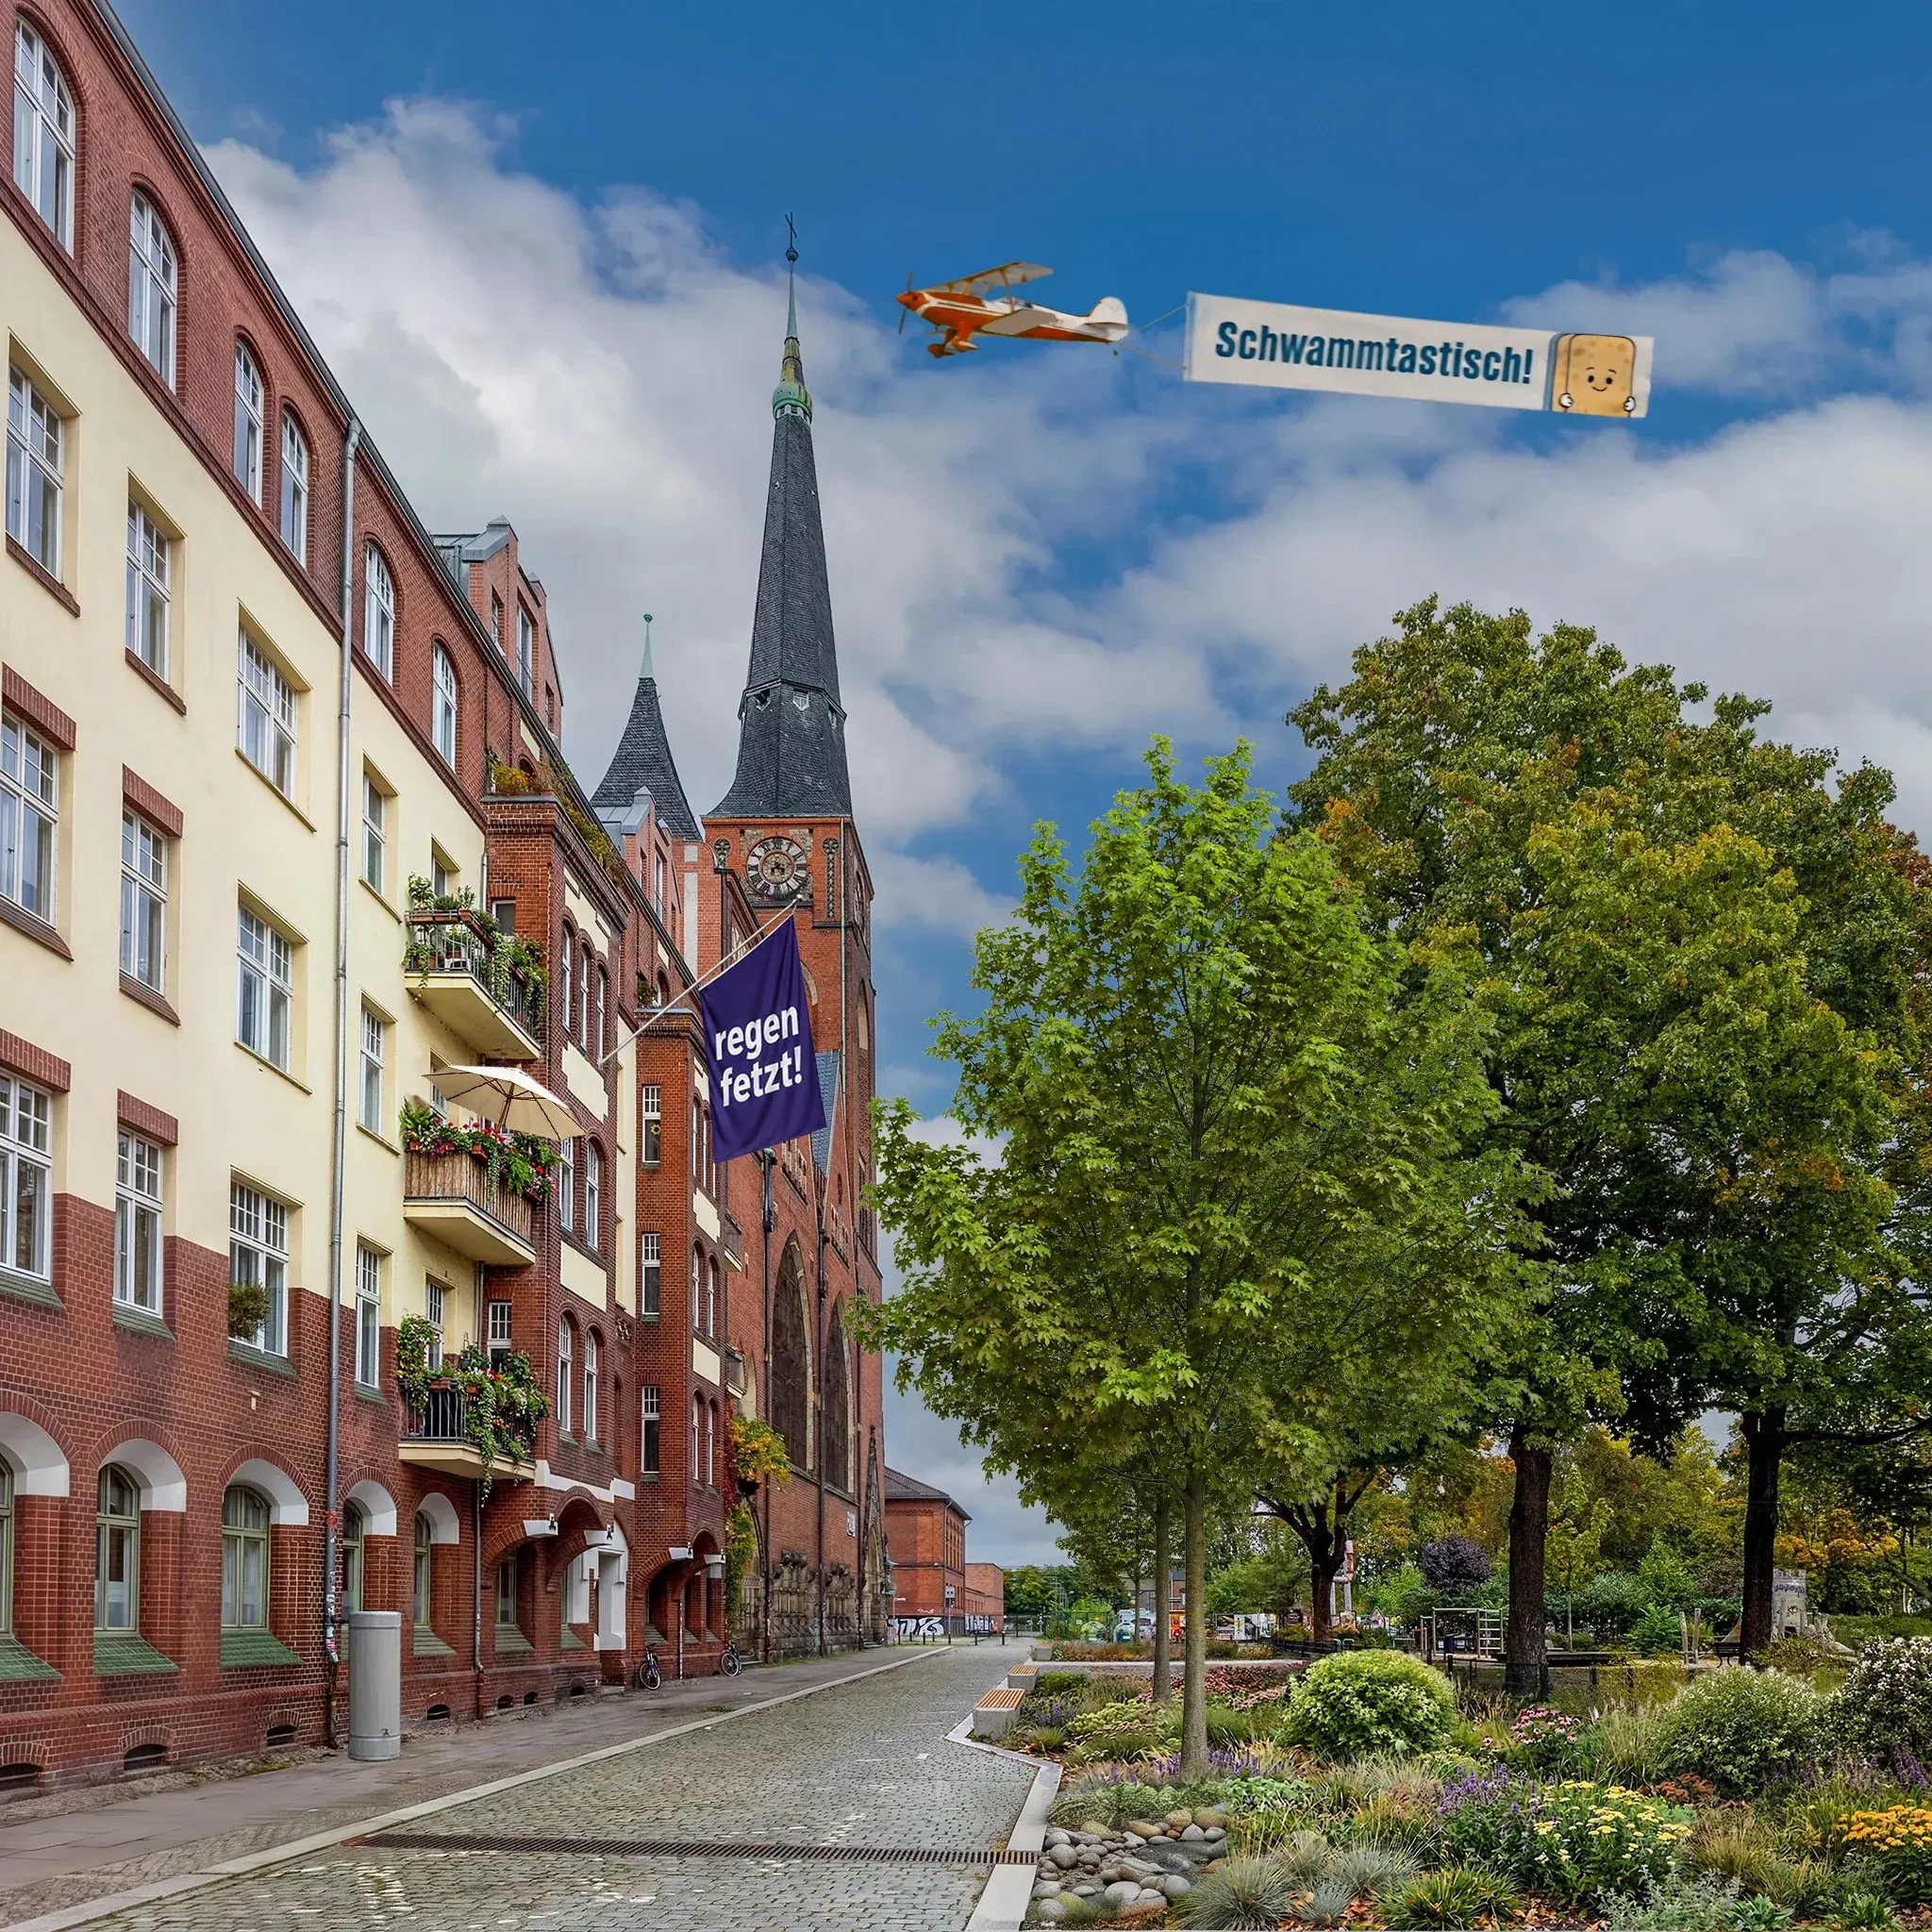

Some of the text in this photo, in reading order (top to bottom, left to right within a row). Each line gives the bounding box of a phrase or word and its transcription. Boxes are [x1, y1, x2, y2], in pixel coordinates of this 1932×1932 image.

[1215, 321, 1534, 385] Schwammtastisch!
[715, 1006, 799, 1061] regen
[720, 1044, 803, 1108] fetzt!
